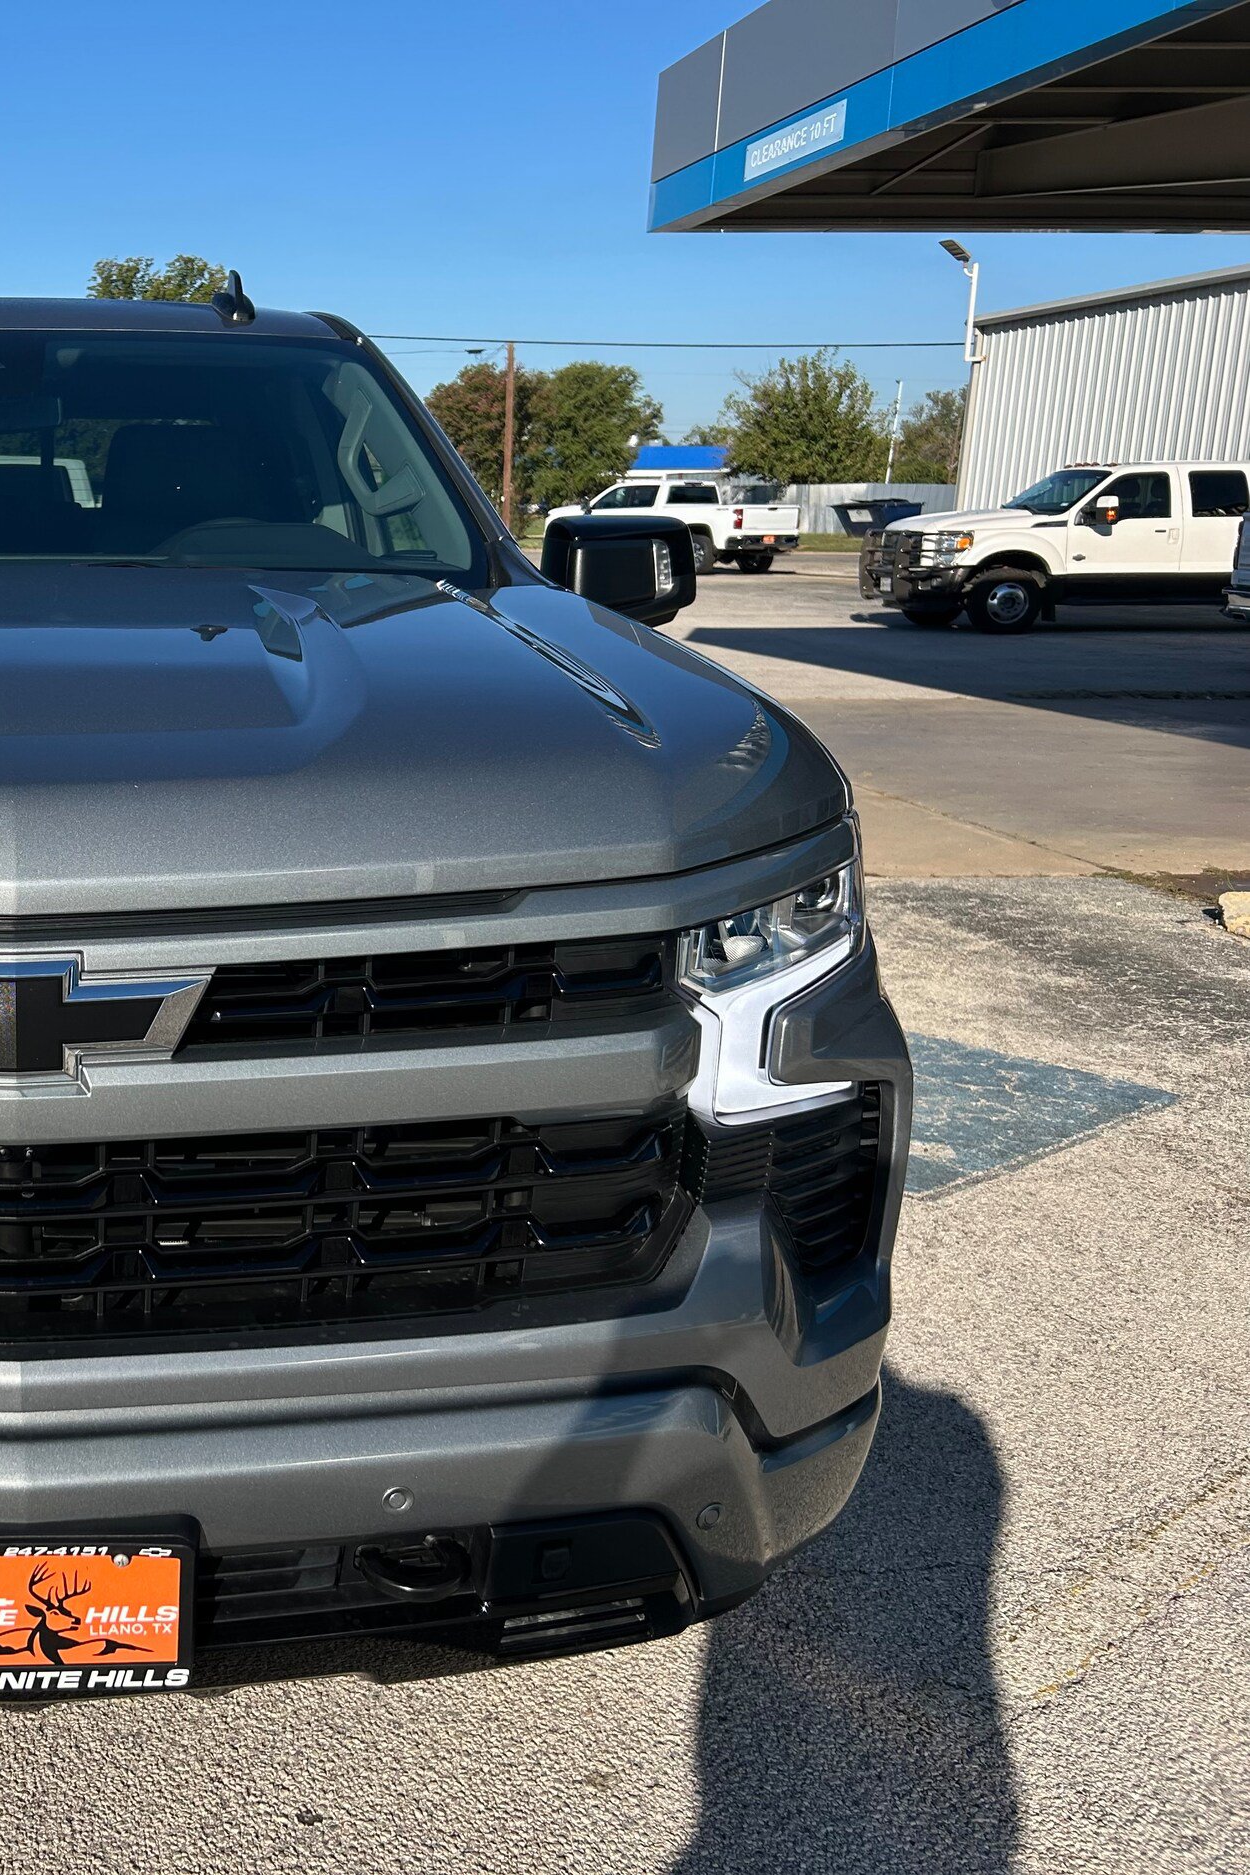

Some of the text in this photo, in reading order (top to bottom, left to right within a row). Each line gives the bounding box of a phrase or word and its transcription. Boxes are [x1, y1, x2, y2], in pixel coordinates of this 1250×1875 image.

[750, 113, 837, 168] CLEARANCE 10 FT
[4, 1546, 109, 1557] 247-4151
[85, 1605, 180, 1624] HILLS
[89, 1623, 172, 1637] LLANO, TX
[87, 1668, 190, 1689] HILLS
